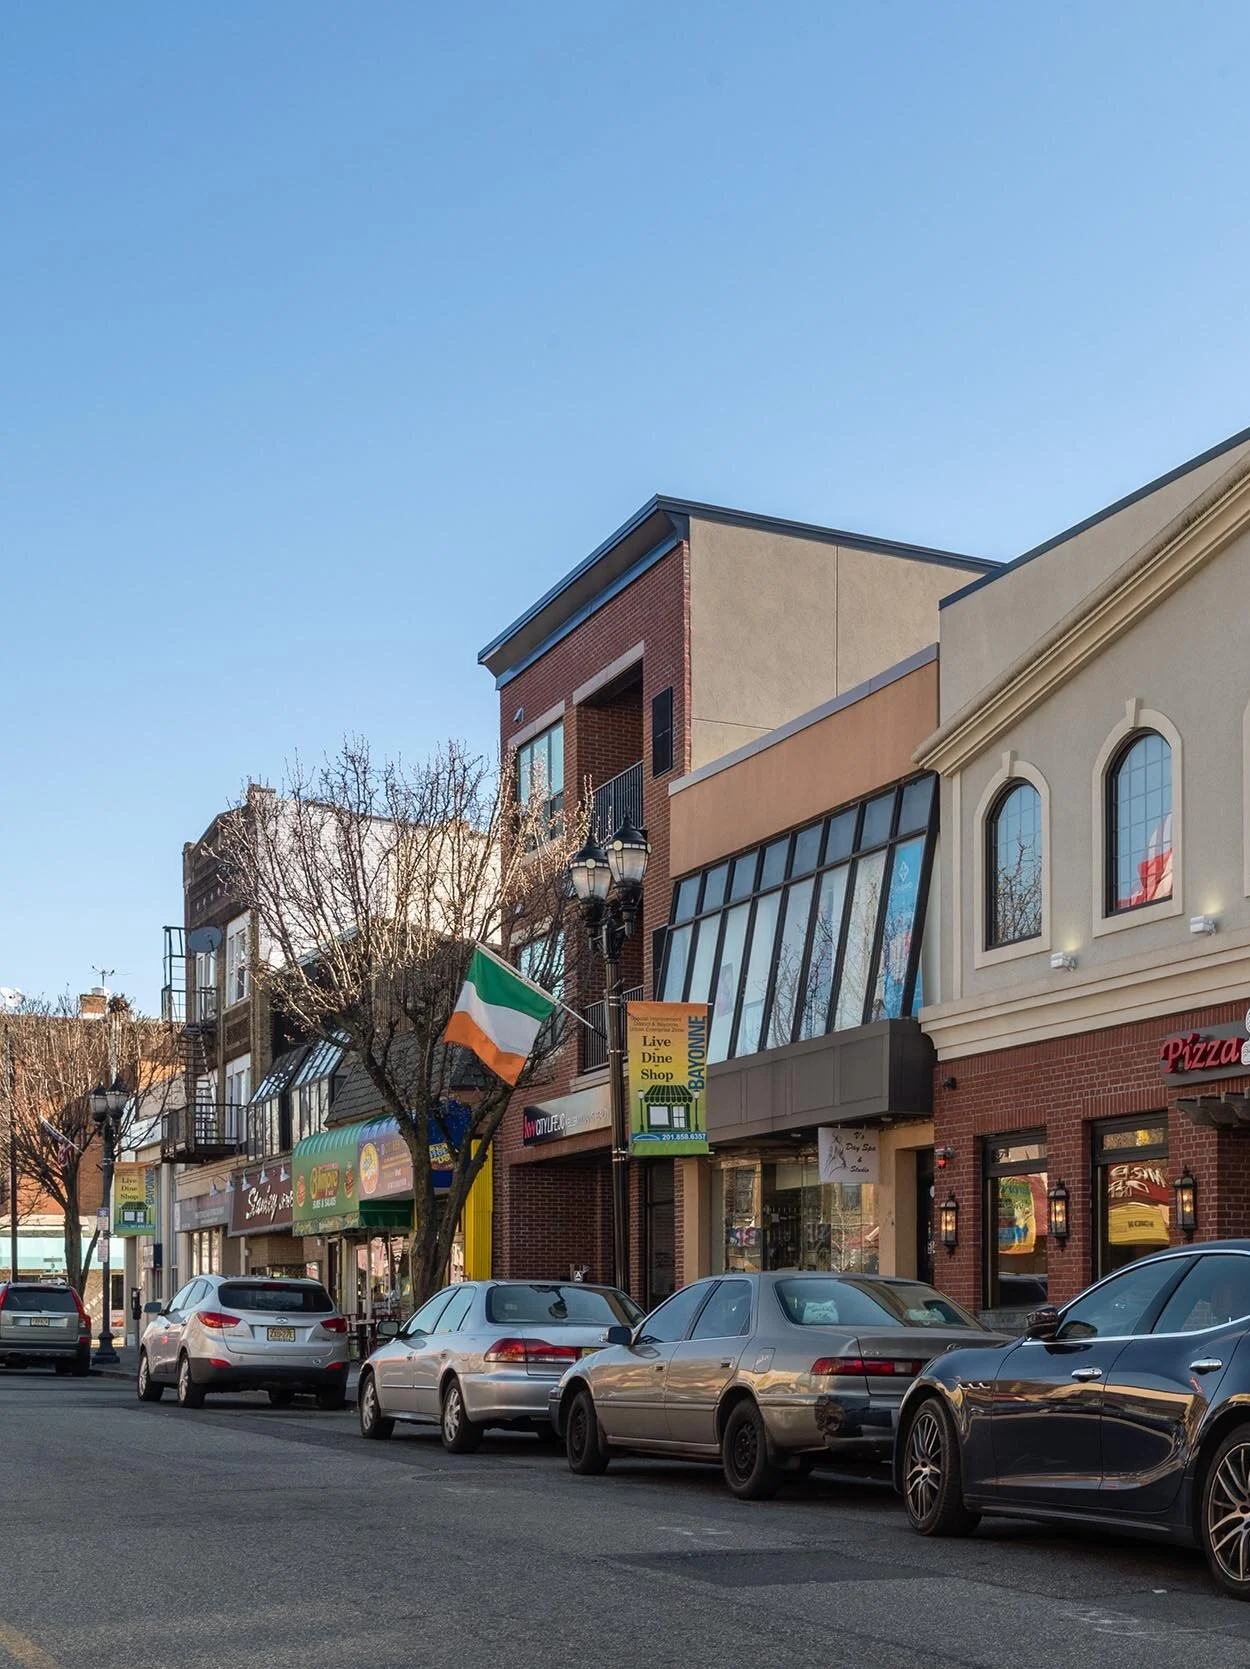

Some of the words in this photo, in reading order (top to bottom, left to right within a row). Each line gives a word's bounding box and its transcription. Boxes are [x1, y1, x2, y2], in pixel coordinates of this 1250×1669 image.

[642, 1035, 672, 1047] Live
[641, 1052, 673, 1064] Dine
[687, 1015, 707, 1091] BAYONNE
[1160, 1033, 1241, 1074] Pizza
[640, 1068, 674, 1083] Shop
[845, 1142, 860, 1152] Day
[862, 1143, 877, 1153] Spa
[850, 1165, 870, 1173] Studio
[120, 1193, 139, 1201] Shop
